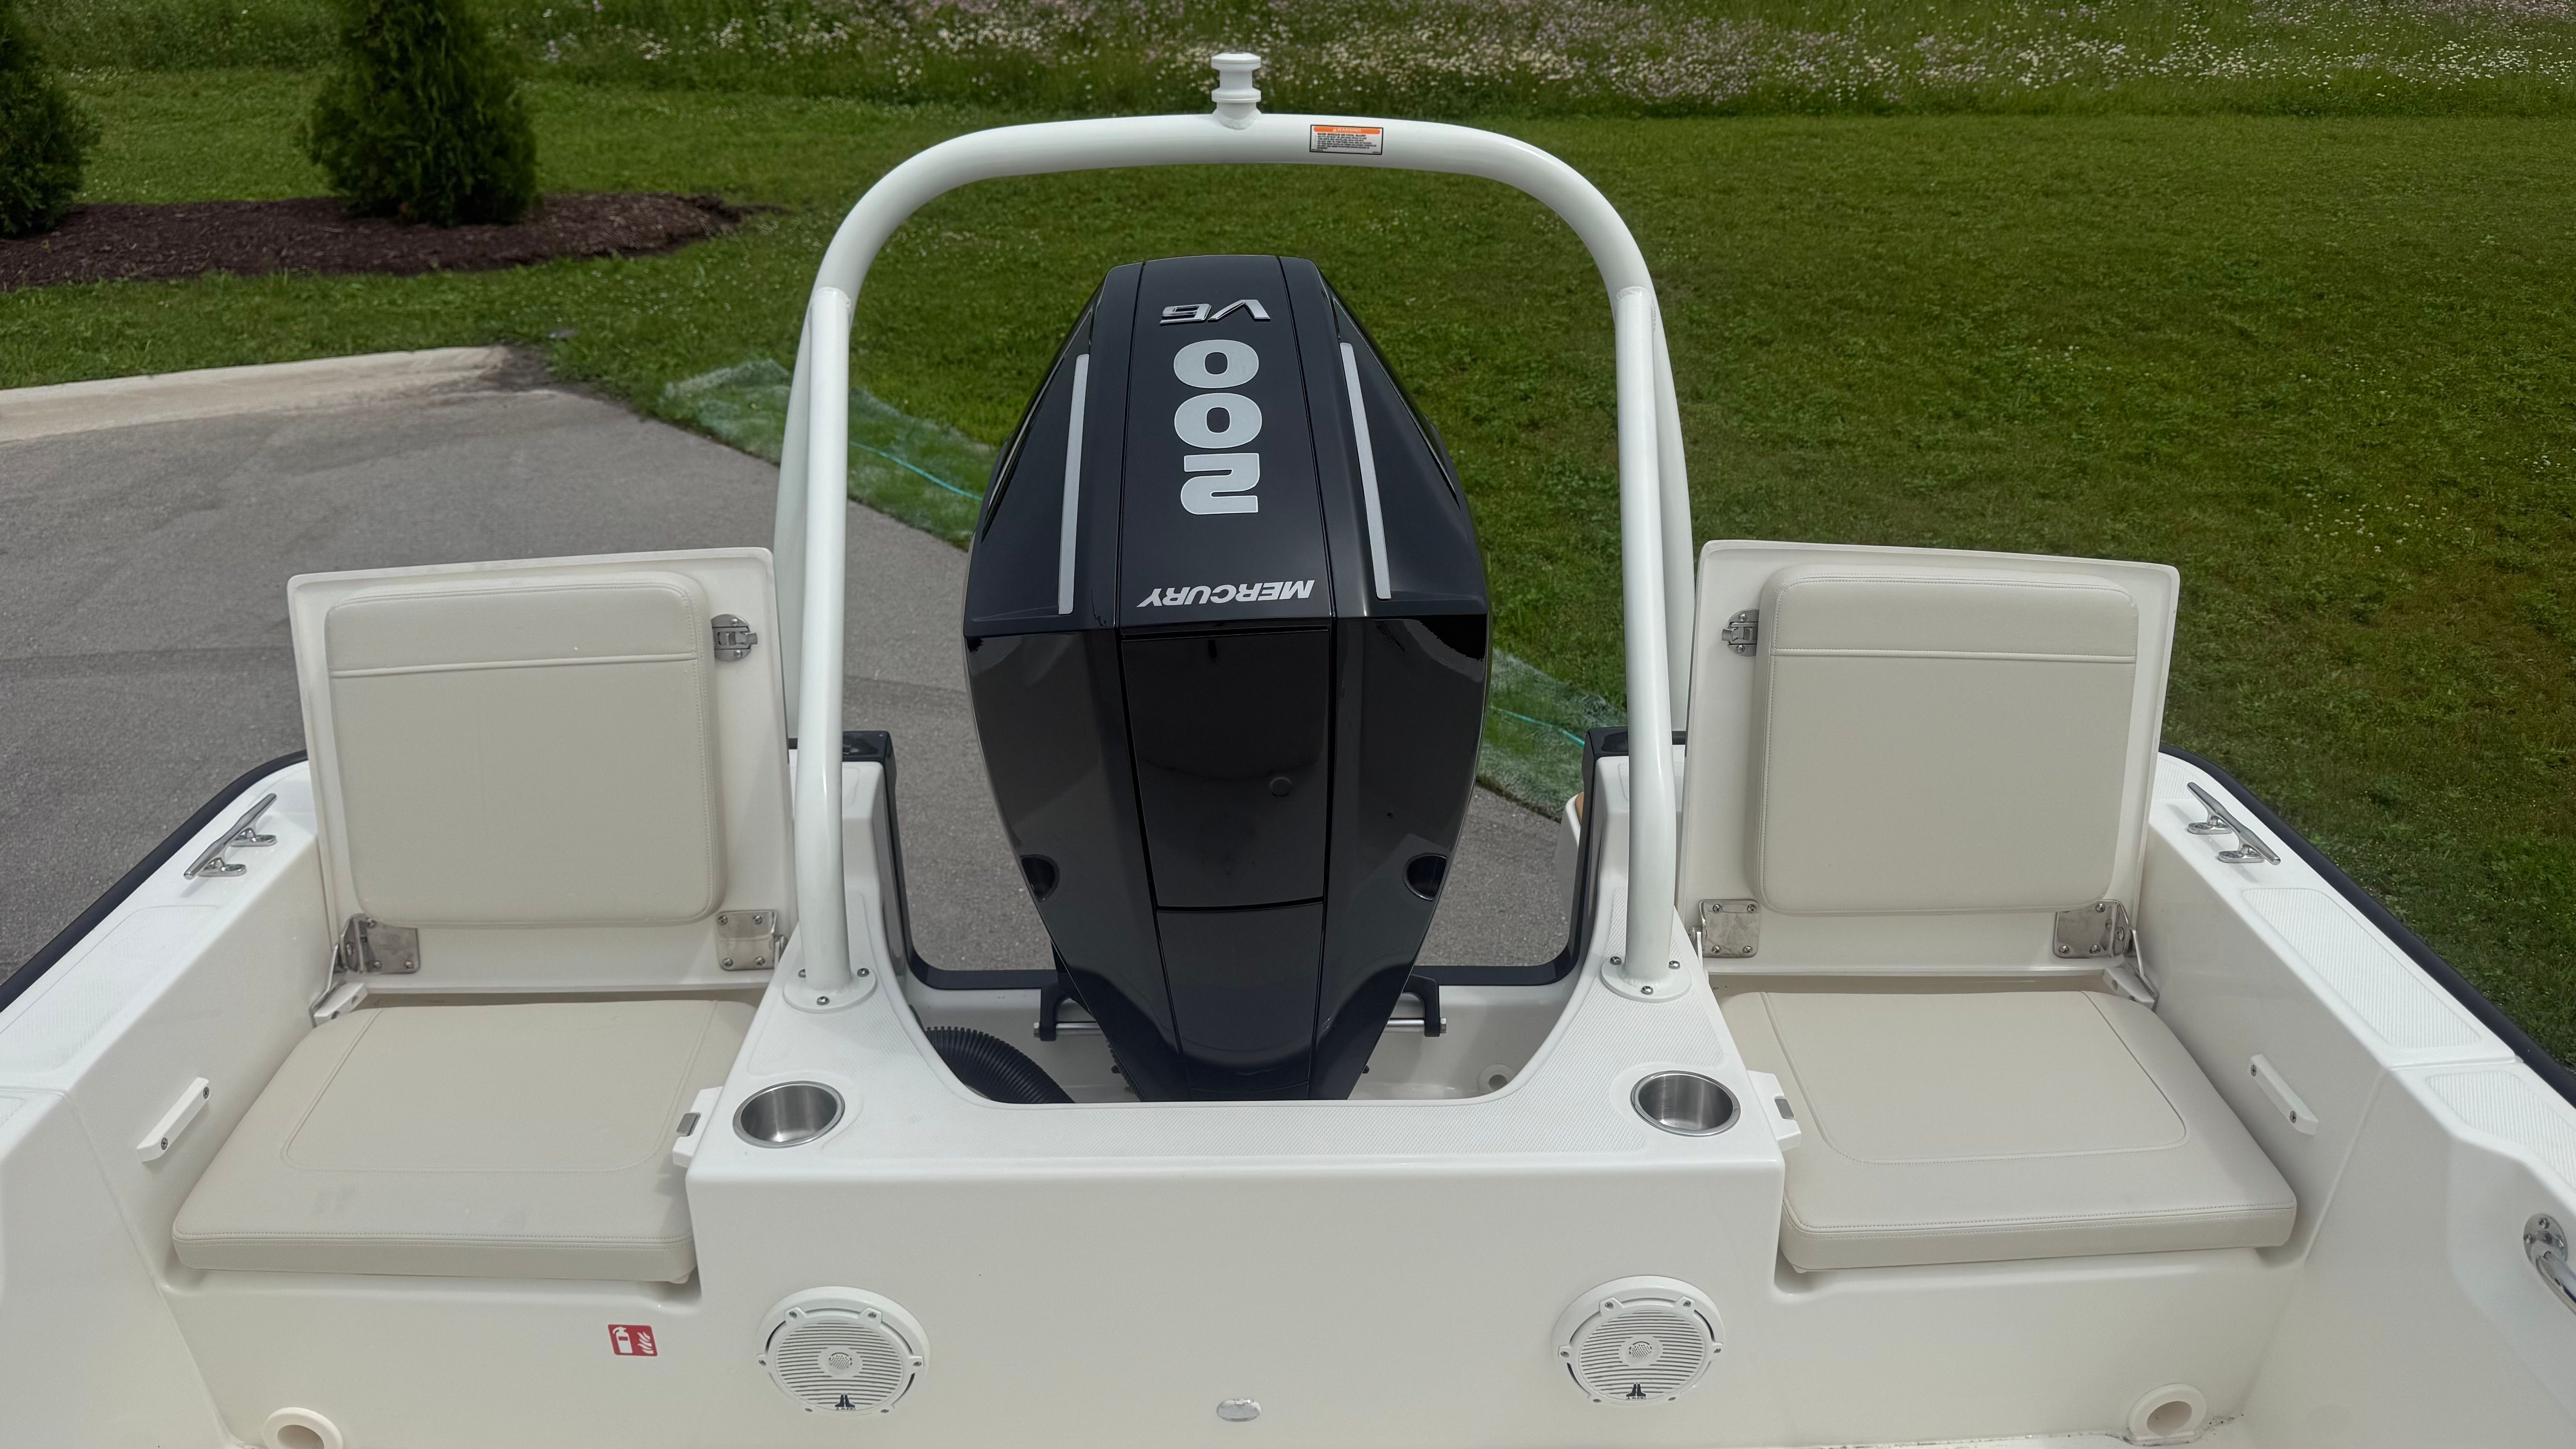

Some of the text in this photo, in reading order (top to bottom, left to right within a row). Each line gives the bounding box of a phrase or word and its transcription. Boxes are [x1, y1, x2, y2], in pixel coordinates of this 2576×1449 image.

[1159, 299, 1270, 325] V6
[1173, 339, 1262, 515] 200
[1136, 580, 1315, 608] MERCURY
